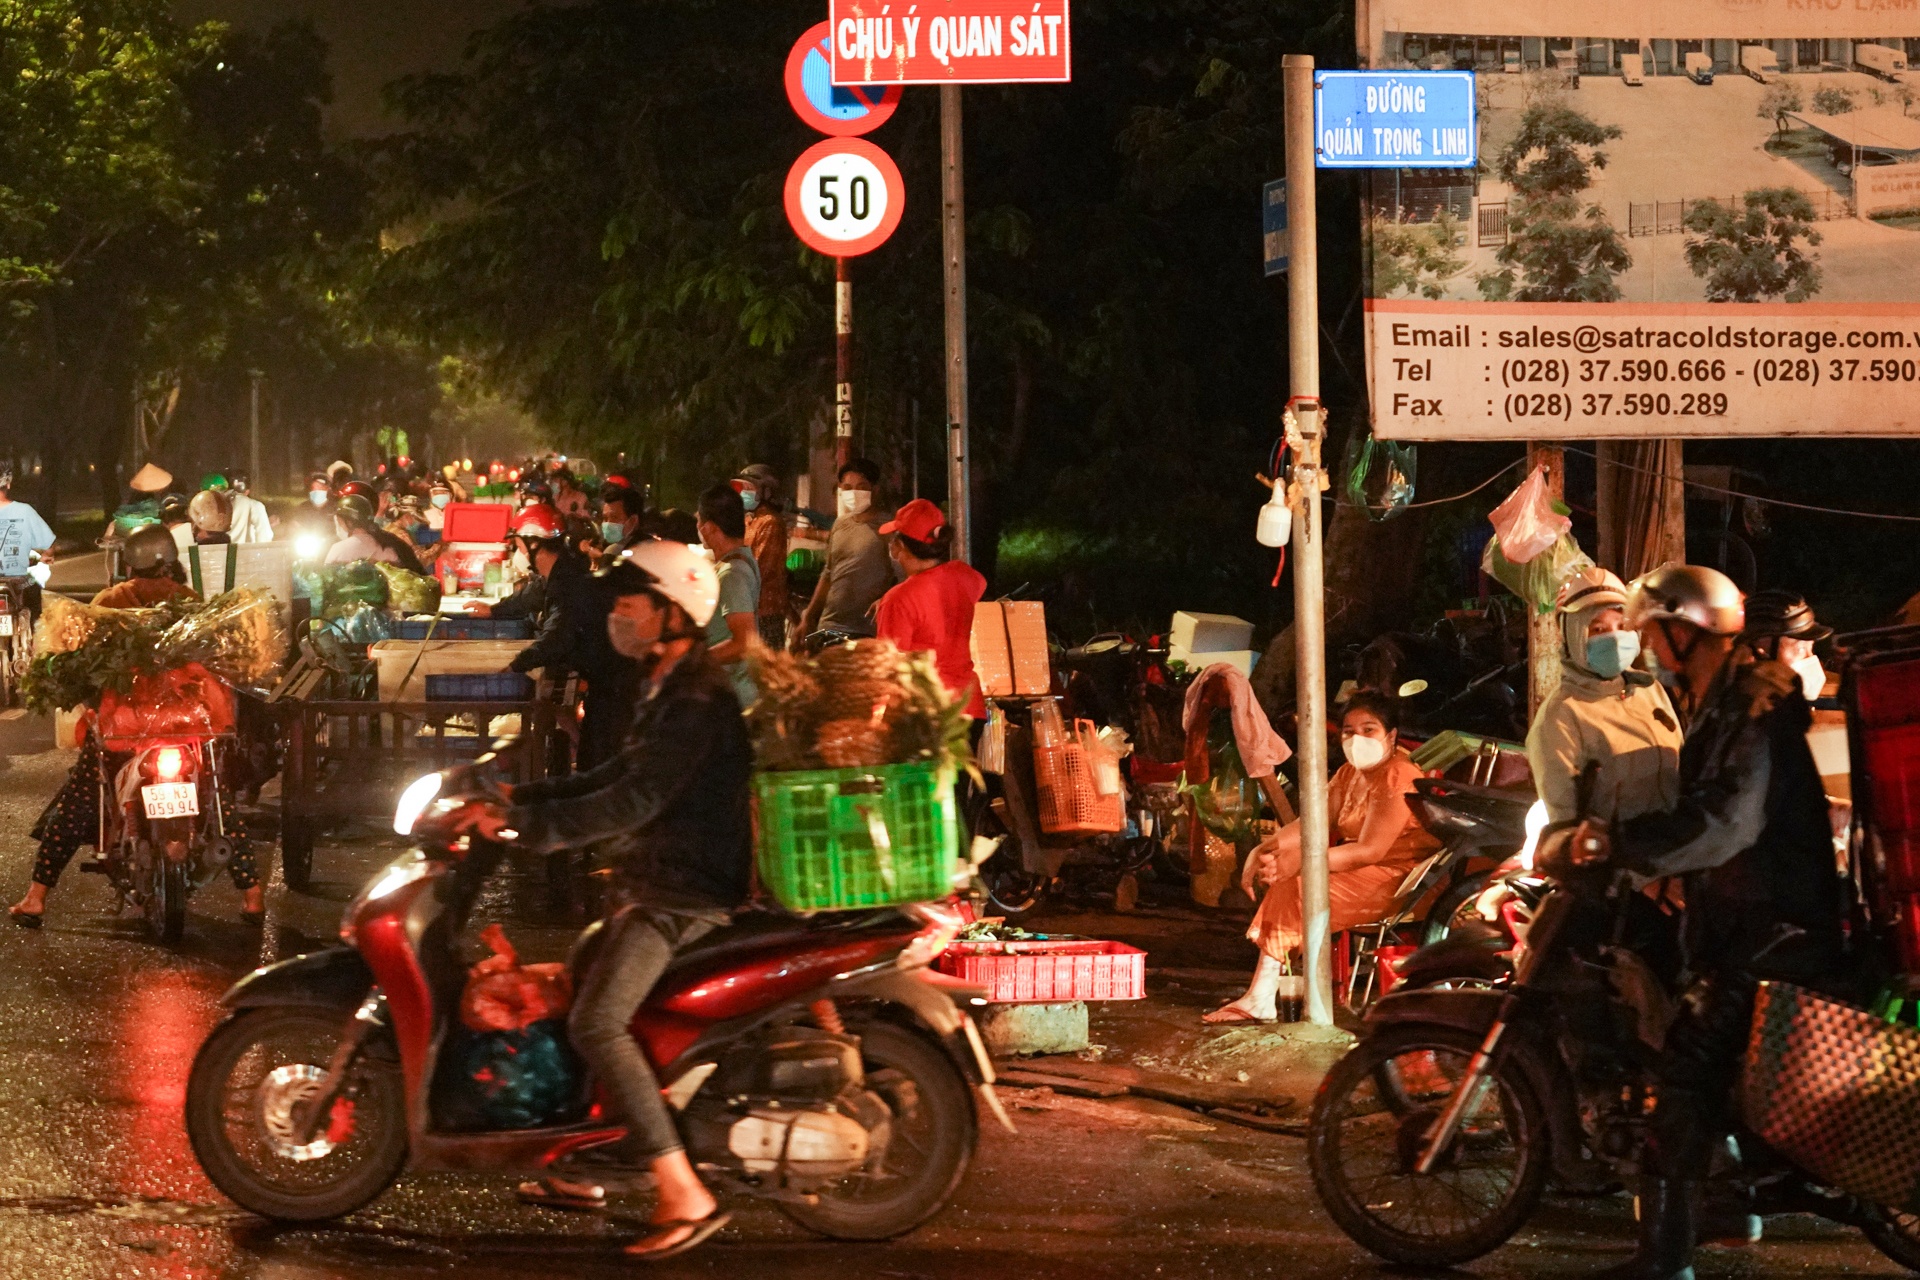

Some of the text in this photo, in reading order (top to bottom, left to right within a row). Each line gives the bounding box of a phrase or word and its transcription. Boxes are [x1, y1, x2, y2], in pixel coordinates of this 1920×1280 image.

[837, 2, 1062, 66] CHÚ Ý QUAN SÁT
[1366, 78, 1426, 114] ĐƯỜNG
[1324, 117, 1467, 160] QUẢN TRỌNG LINH
[819, 175, 870, 221] 50
[1392, 323, 1470, 348] Email
[1392, 358, 1432, 382] Tel
[1501, 359, 1570, 388] (028)
[1579, 359, 1726, 382] 37.590.666
[1753, 359, 1820, 387] (028)
[1393, 393, 1443, 416] Fax
[1504, 393, 1572, 422] (028)
[1581, 393, 1728, 416] 37.590.289
[148, 800, 195, 816] 059.94
